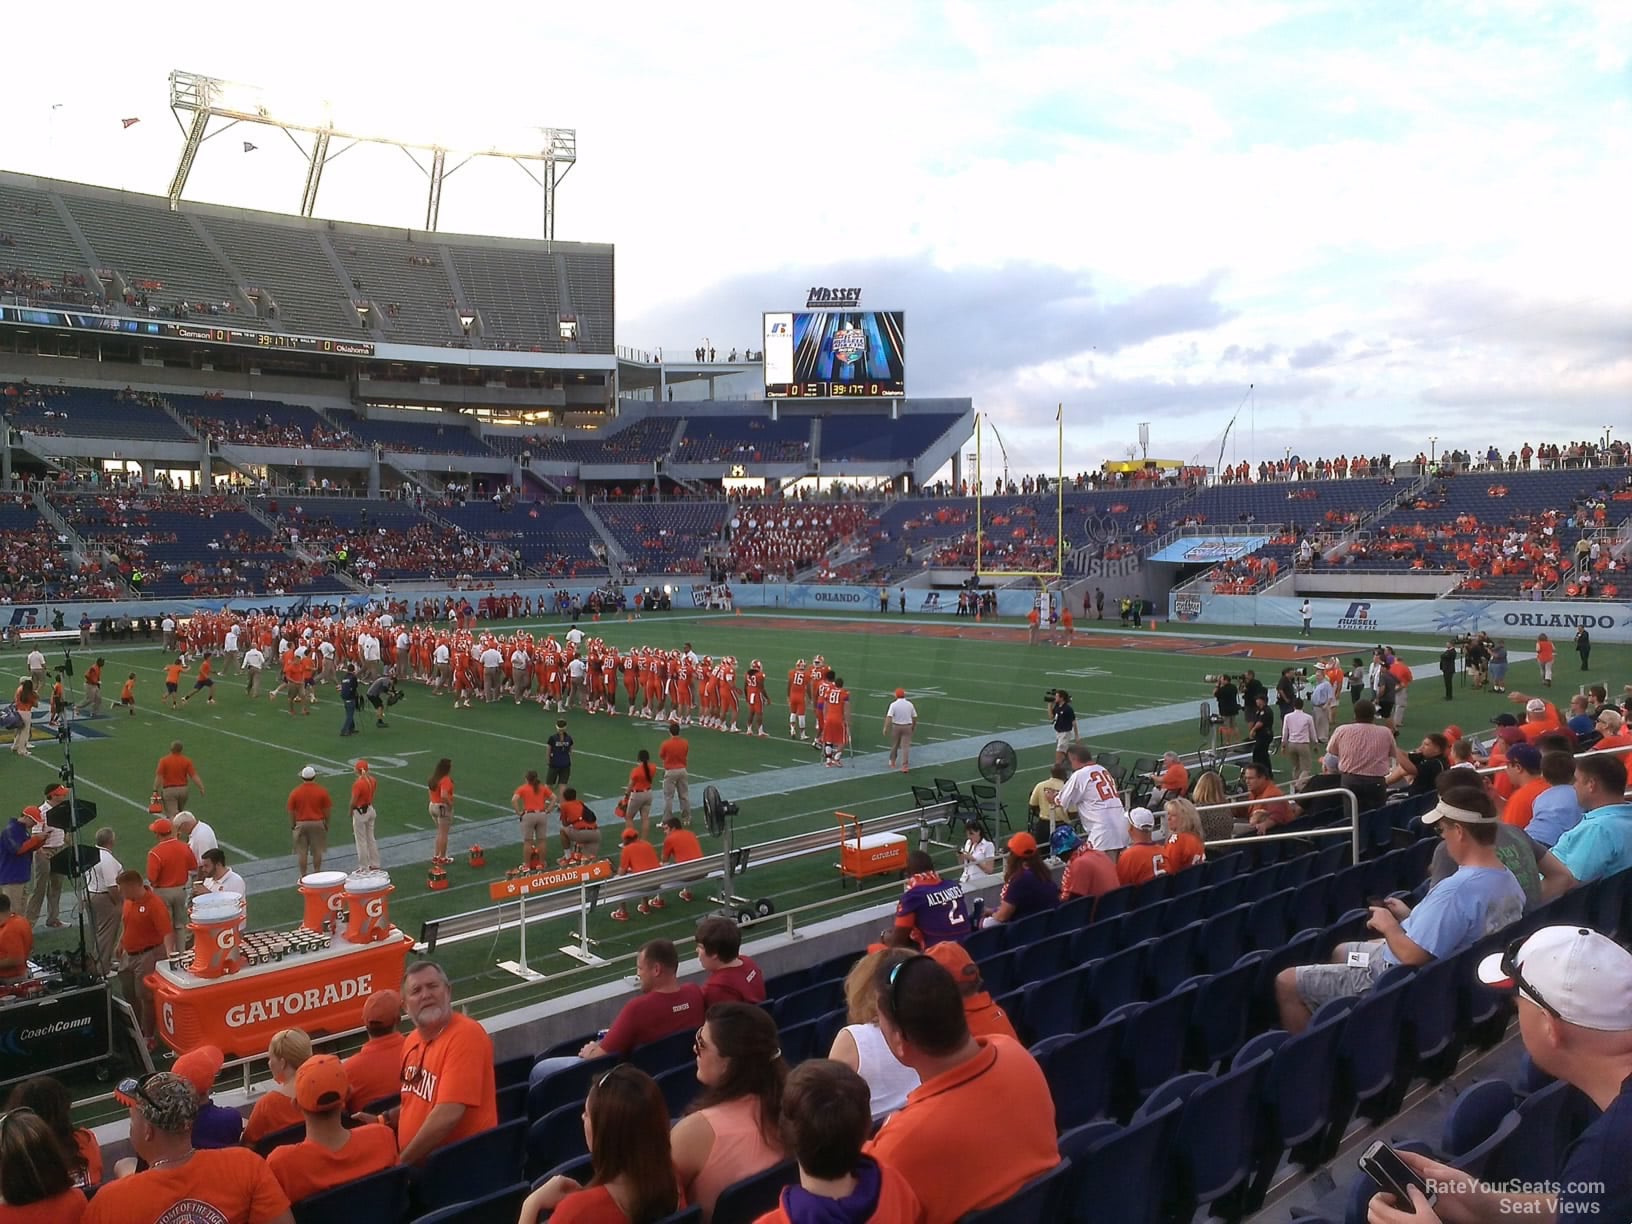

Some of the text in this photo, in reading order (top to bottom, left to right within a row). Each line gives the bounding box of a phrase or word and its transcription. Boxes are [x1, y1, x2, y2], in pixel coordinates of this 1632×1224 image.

[808, 287, 861, 301] MASSEY
[179, 329, 211, 340] Clemson
[217, 331, 223, 340] 0
[258, 334, 284, 346] 39:17
[324, 341, 330, 351] 0
[336, 345, 369, 354] Oklahoma
[792, 386, 798, 396] 0
[872, 385, 878, 395] 0
[1064, 549, 1139, 577] Allstate
[815, 592, 860, 603] ORLANDO
[1338, 618, 1378, 626] RUSSELL
[1503, 613, 1615, 629] ORLANDO
[793, 672, 804, 685] 16
[830, 692, 840, 704] 81
[872, 849, 900, 861] GATORADE
[531, 870, 578, 888] GATORADE
[366, 898, 382, 917] G
[948, 899, 965, 925] 2
[217, 928, 235, 949] G
[225, 974, 373, 1028] GATORADE
[162, 1002, 175, 1035] G
[20, 1016, 92, 1041] CoachComm
